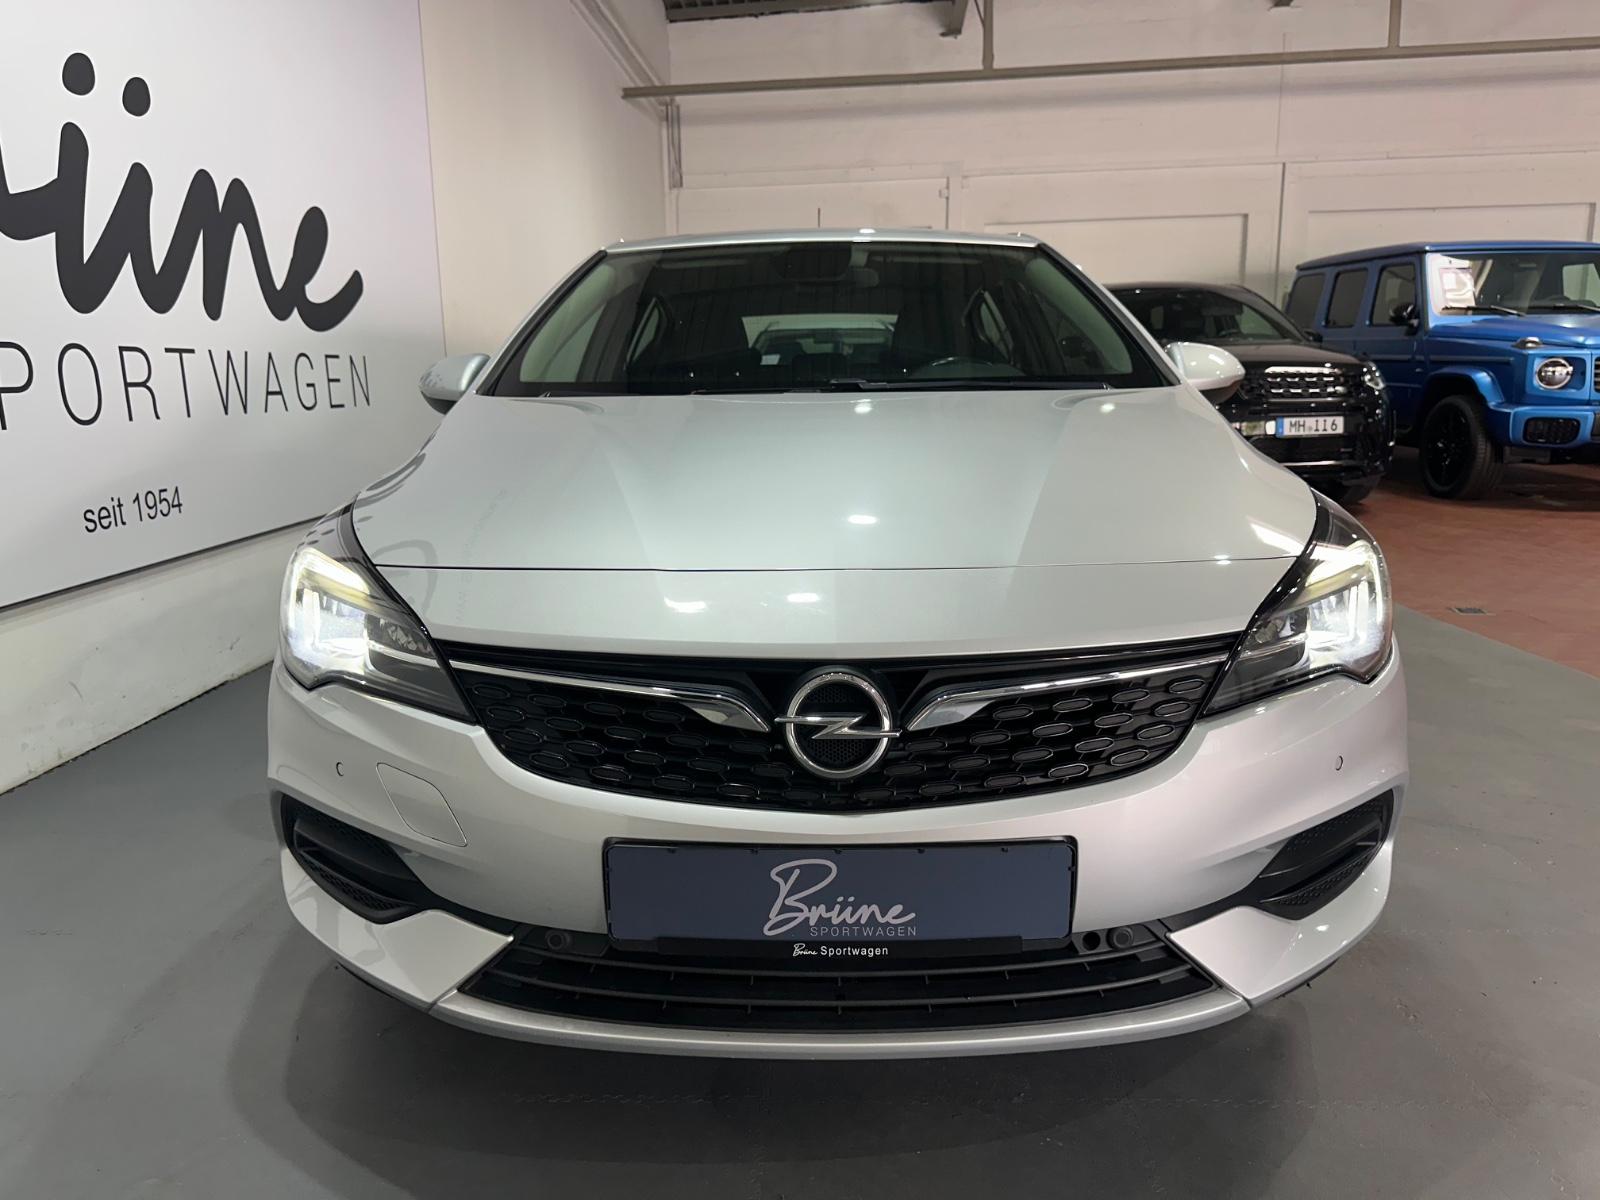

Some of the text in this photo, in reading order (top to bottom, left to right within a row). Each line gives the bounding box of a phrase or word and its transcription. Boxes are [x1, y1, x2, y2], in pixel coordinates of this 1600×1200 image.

[83, 485, 183, 533] seit 1954
[763, 858, 916, 936] Brüne
[810, 926, 917, 937] SPORTWAGEN
[792, 942, 889, 958] Brüne Sportwagen
